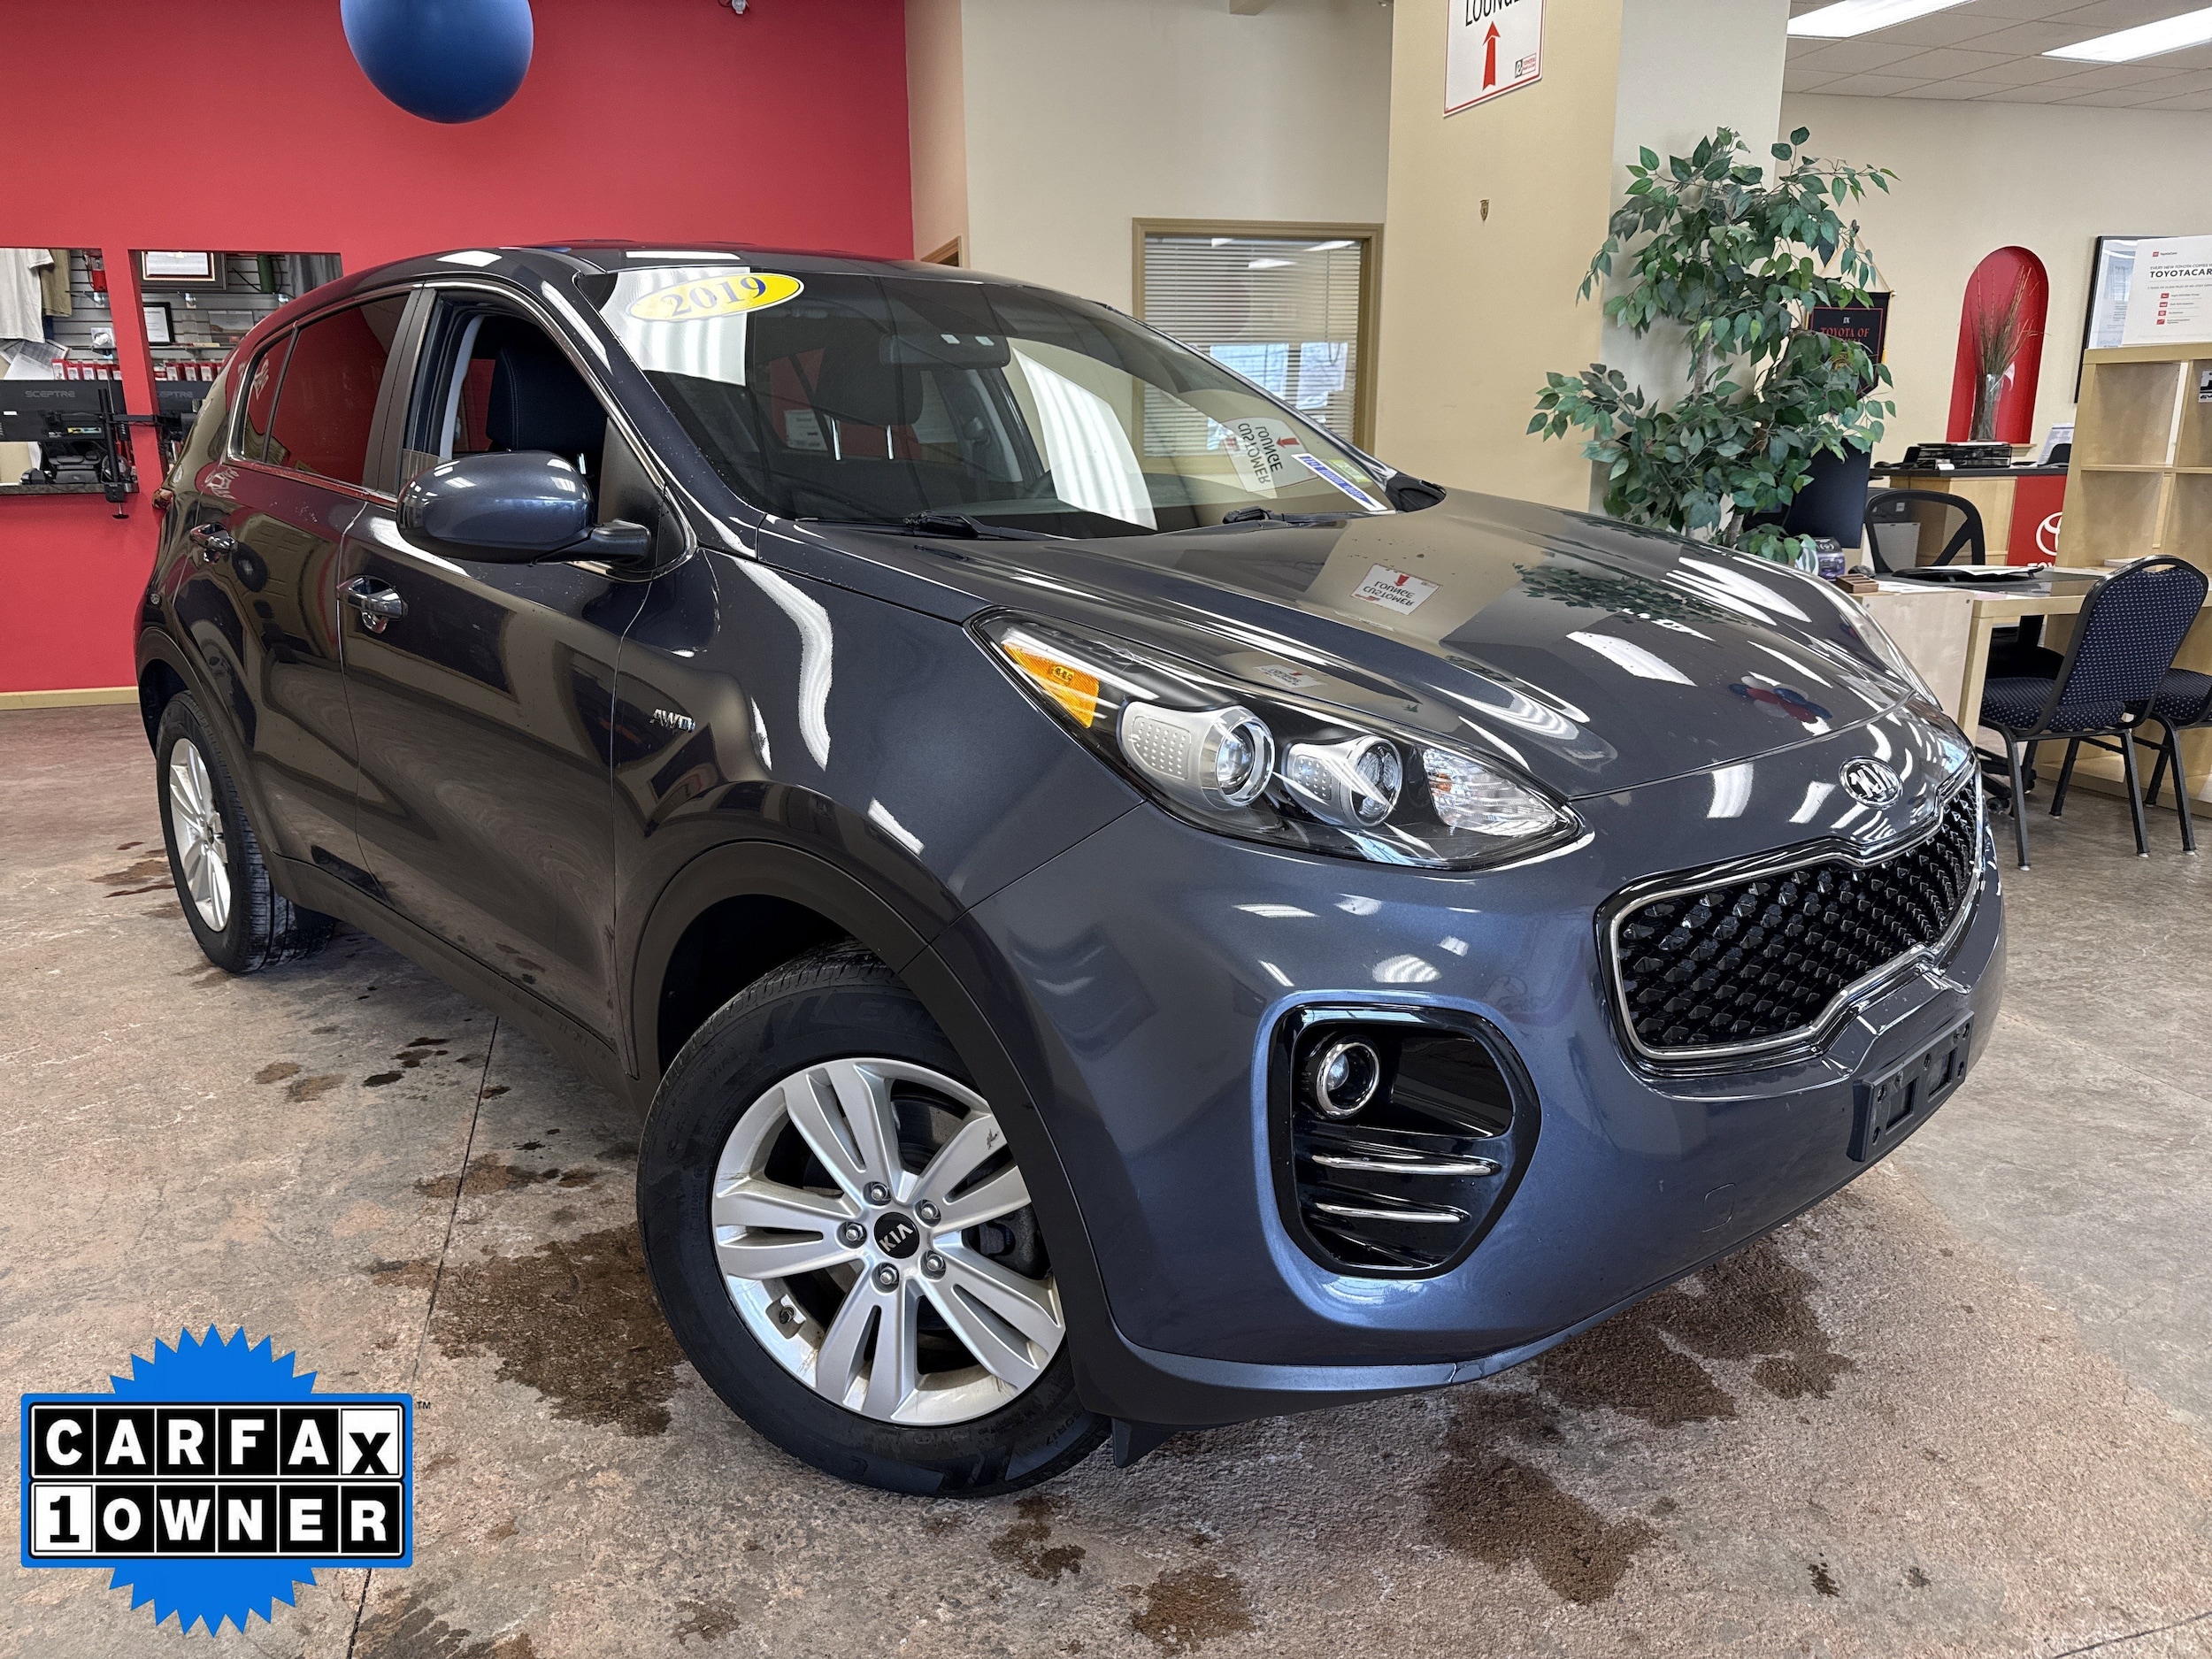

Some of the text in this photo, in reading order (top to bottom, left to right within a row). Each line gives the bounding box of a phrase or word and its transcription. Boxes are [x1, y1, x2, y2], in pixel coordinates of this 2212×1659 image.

[1465, 0, 1522, 27] LOU
[661, 276, 767, 317] 2019
[1821, 327, 1870, 338] TOYOTA OF
[649, 708, 696, 733] AWD
[879, 1223, 913, 1252] KIA
